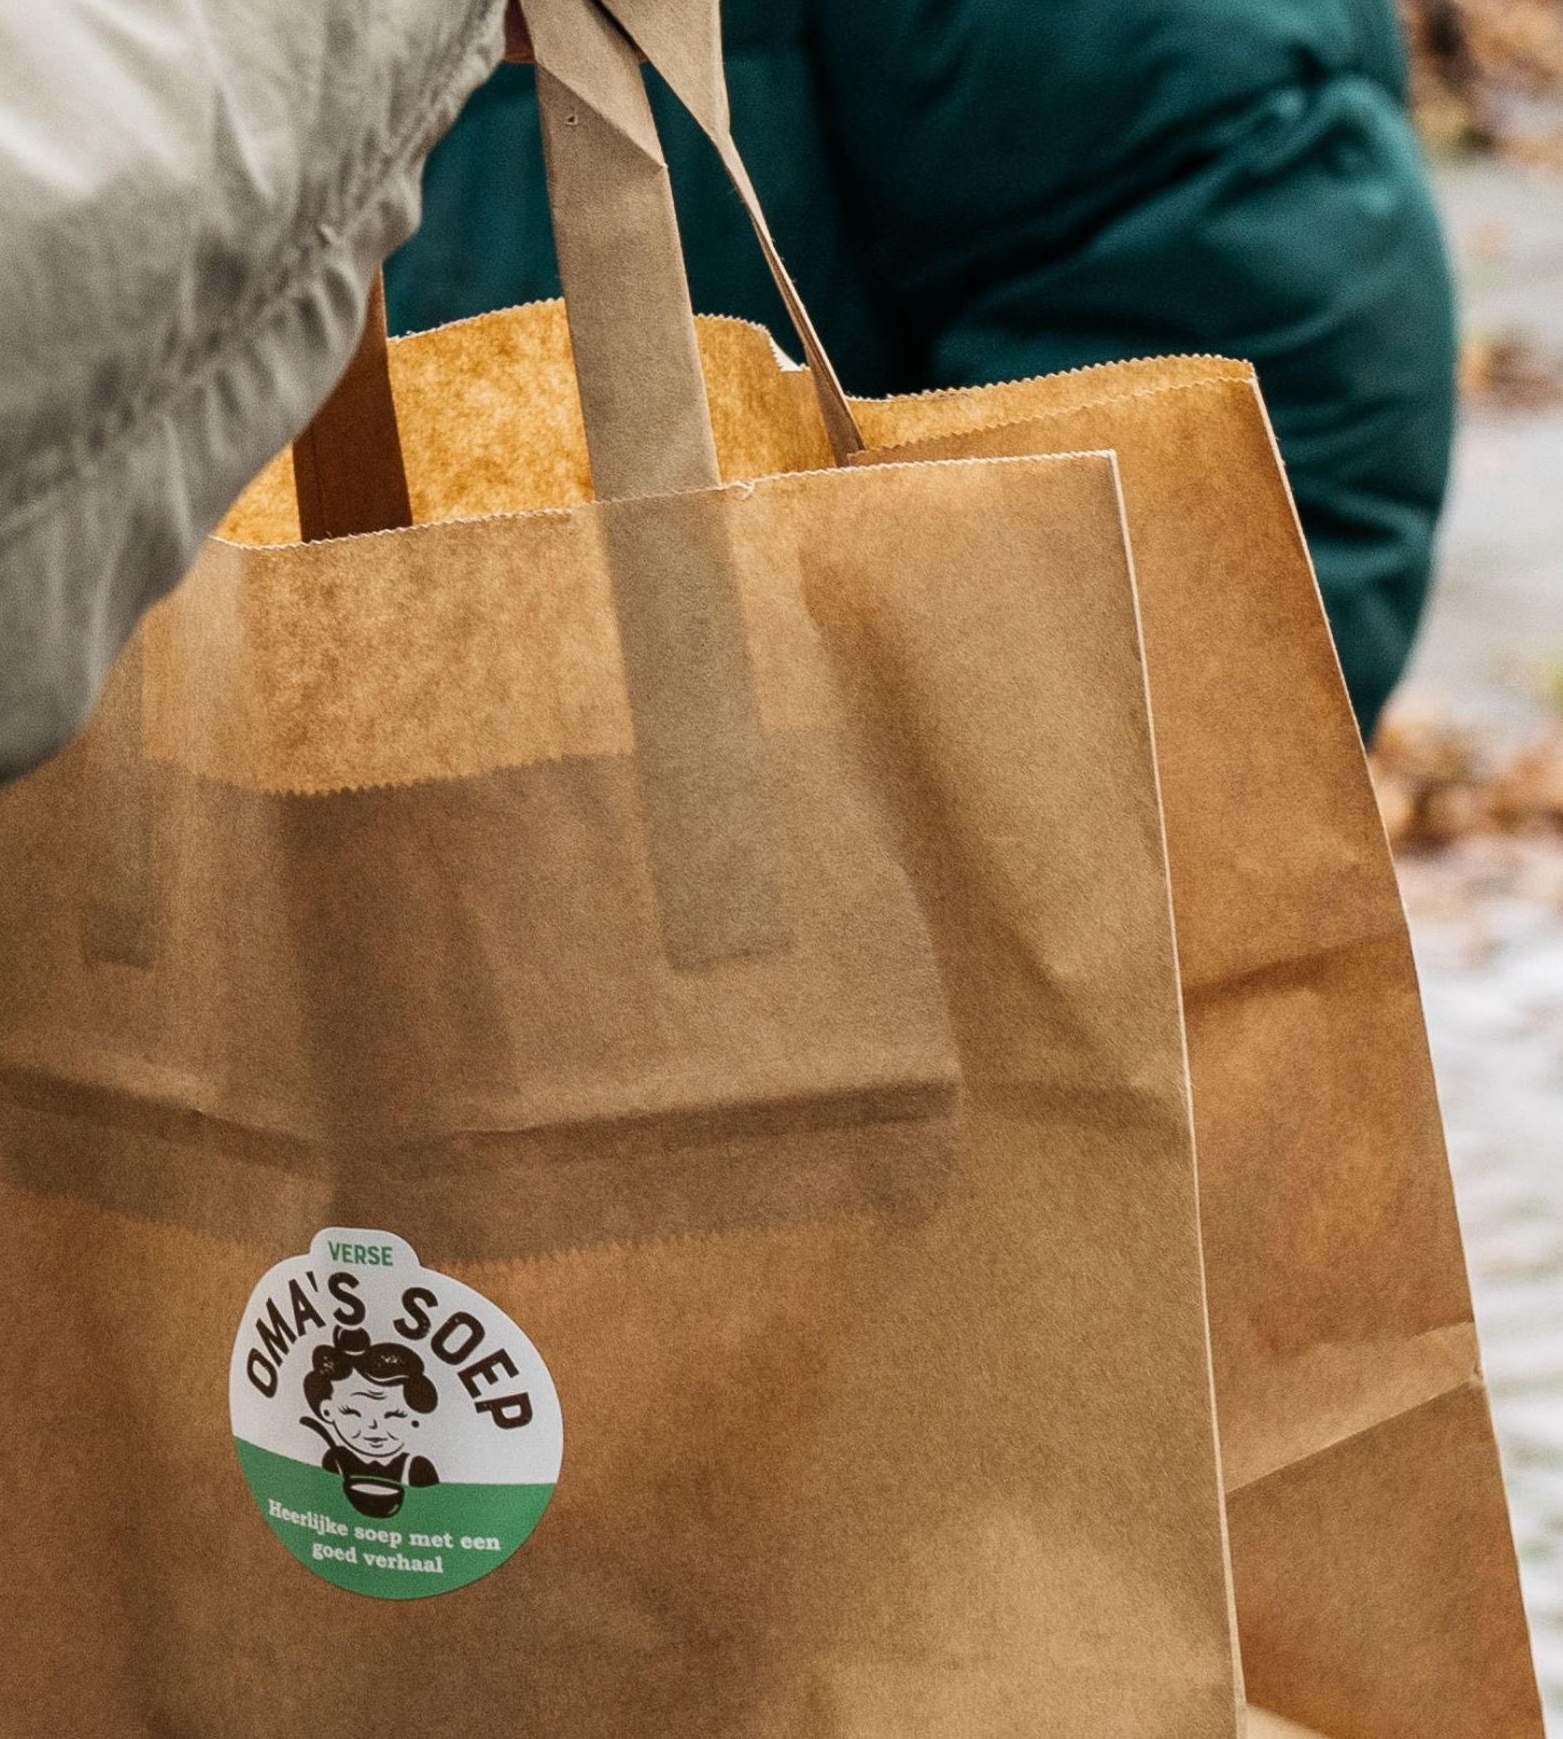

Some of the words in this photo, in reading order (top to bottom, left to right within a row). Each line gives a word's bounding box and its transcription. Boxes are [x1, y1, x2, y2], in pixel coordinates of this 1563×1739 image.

[327, 1240, 393, 1267] VERSE
[246, 1270, 366, 1399] OMA'S
[392, 1286, 533, 1430] SOEP
[268, 1498, 348, 1537] Heerlijke
[354, 1527, 402, 1548] soep
[409, 1531, 453, 1549] met
[460, 1532, 501, 1551] een
[311, 1540, 357, 1565] goed
[363, 1551, 444, 1575] verhaal
